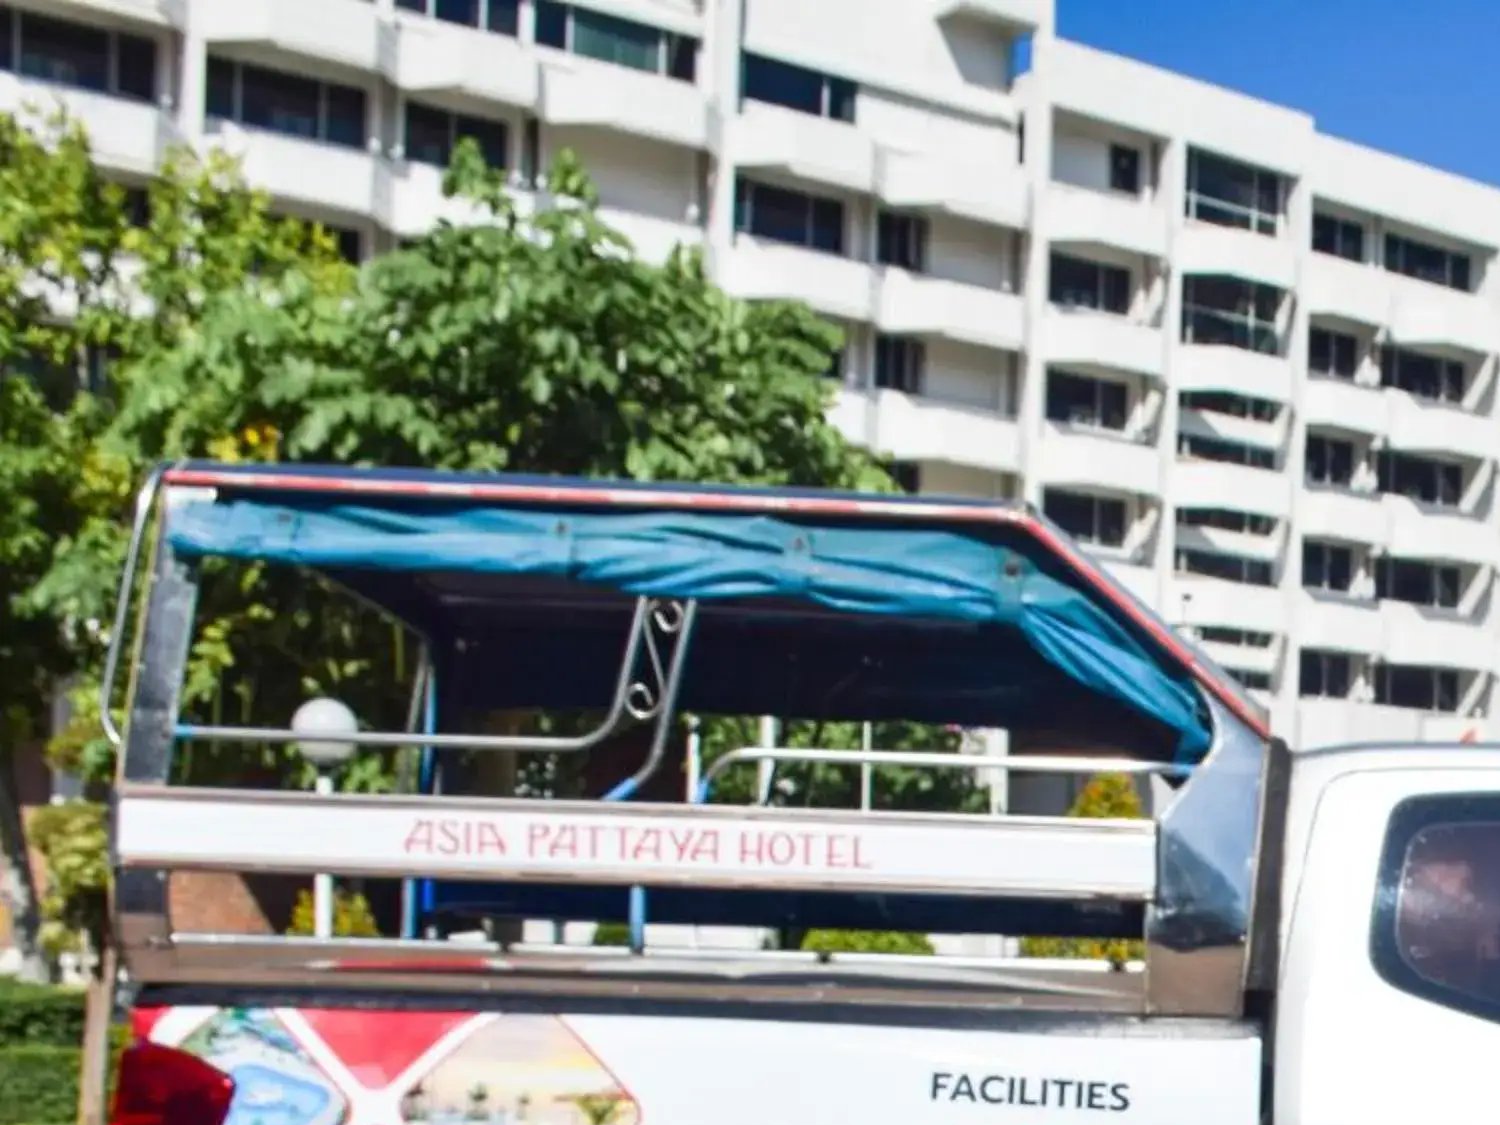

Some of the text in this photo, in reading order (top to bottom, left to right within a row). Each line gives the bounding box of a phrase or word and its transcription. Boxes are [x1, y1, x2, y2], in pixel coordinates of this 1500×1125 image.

[403, 818, 875, 869] ASIA PATTAYA HOTEL
[930, 1072, 1131, 1112] FACILITIES
